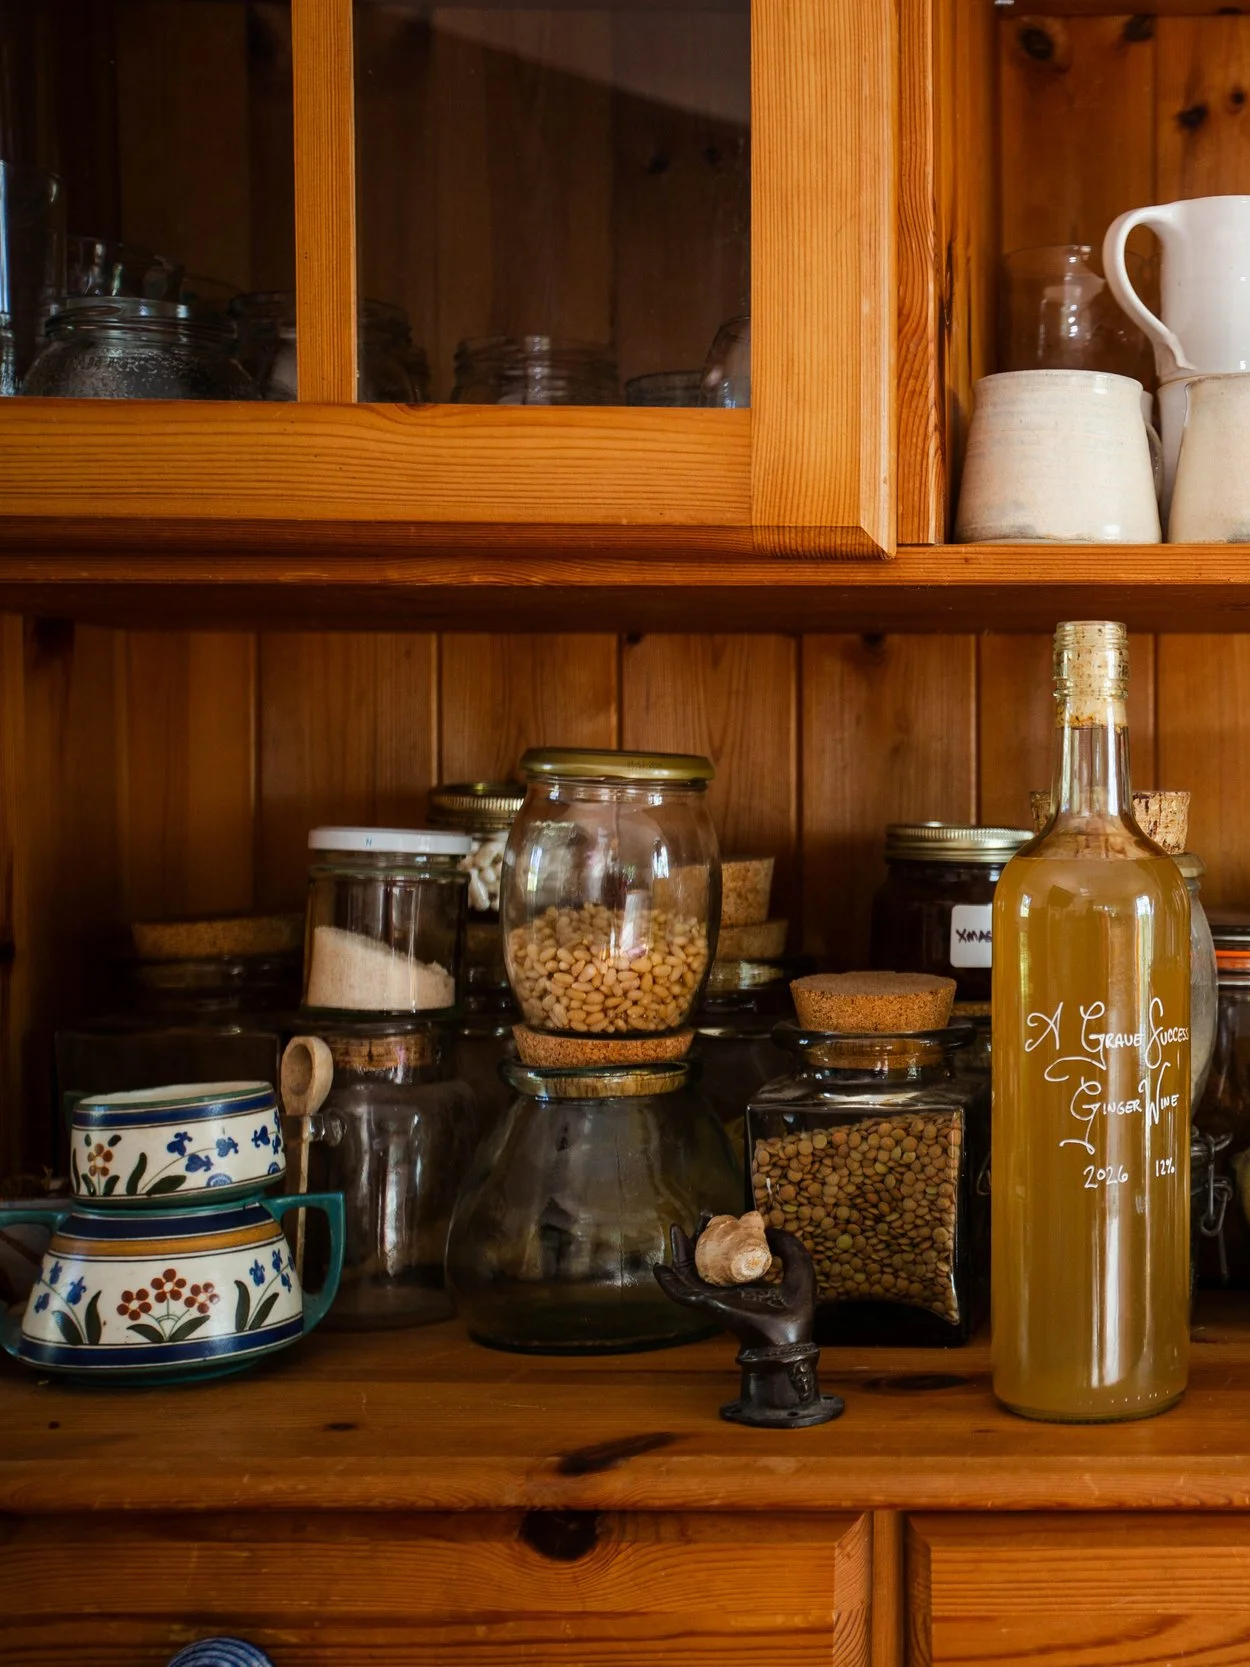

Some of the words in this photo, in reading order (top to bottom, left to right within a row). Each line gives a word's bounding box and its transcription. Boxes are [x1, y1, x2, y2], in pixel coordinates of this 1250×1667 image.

[1024, 1001, 1064, 1052] A
[1059, 1076, 1142, 1155] GINGER
[1138, 1062, 1180, 1126] WINE
[1083, 1165, 1129, 1188] 2026
[1155, 1158, 1175, 1177] 12%
